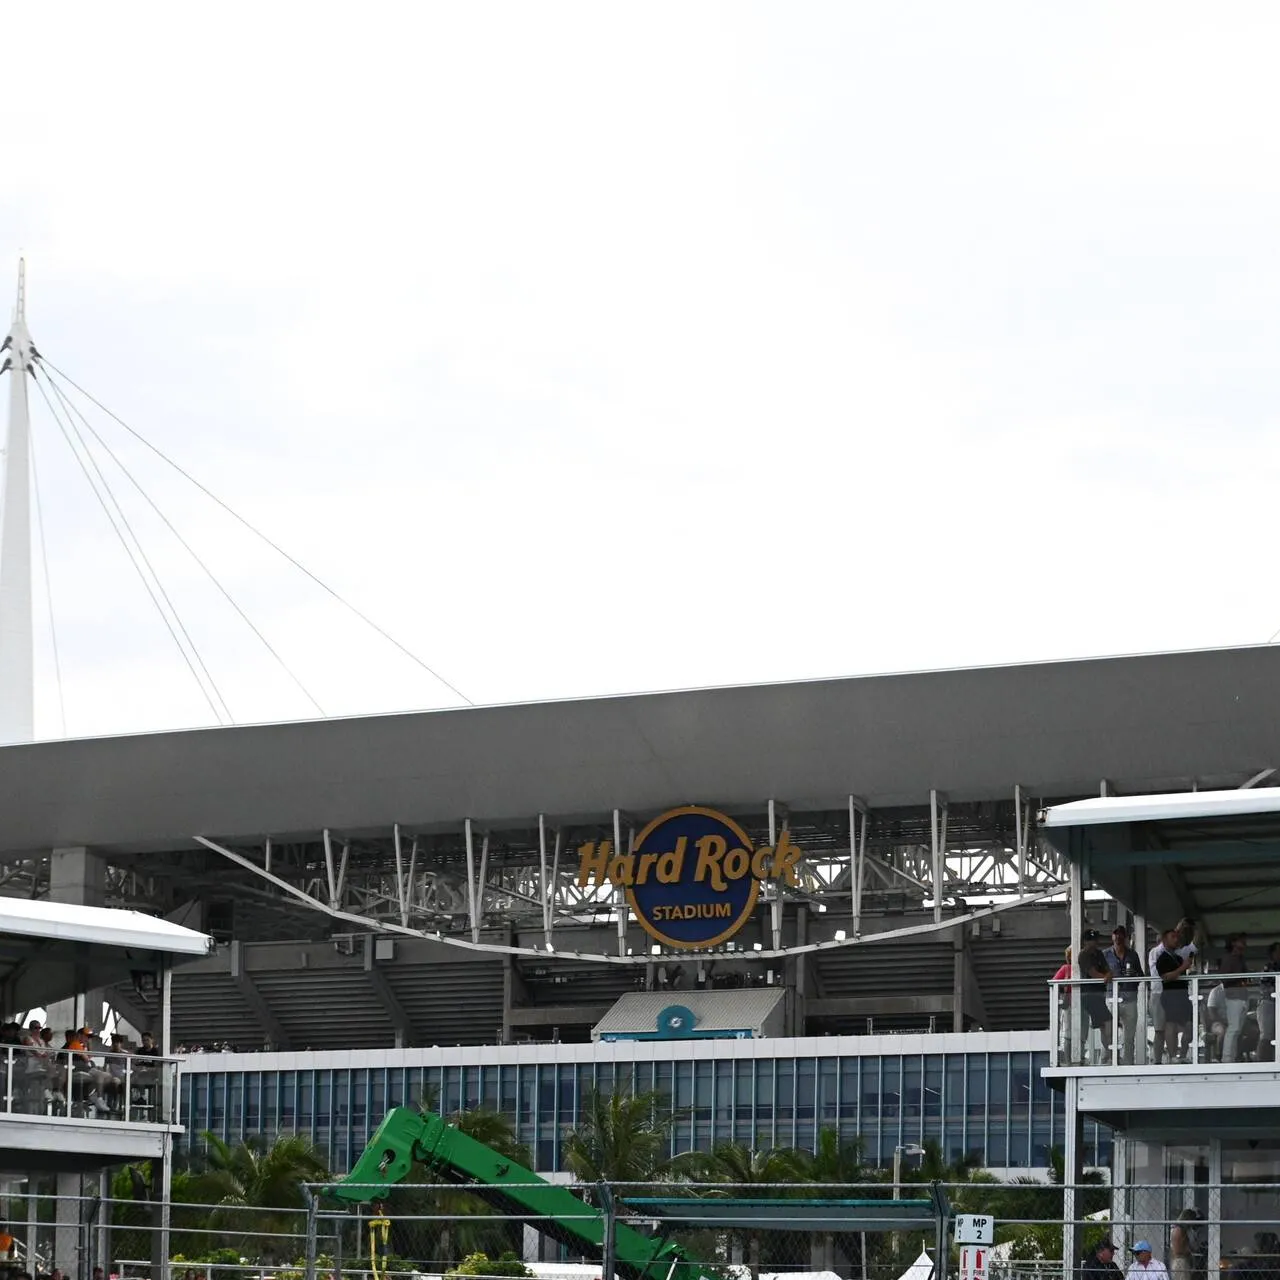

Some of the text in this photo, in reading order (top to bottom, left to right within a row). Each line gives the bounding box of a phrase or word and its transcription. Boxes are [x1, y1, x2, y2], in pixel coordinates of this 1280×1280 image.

[578, 830, 802, 892] Hard Rock
[652, 903, 732, 921] STADIUM
[972, 1218, 987, 1228] MP
[976, 1230, 983, 1240] 2
